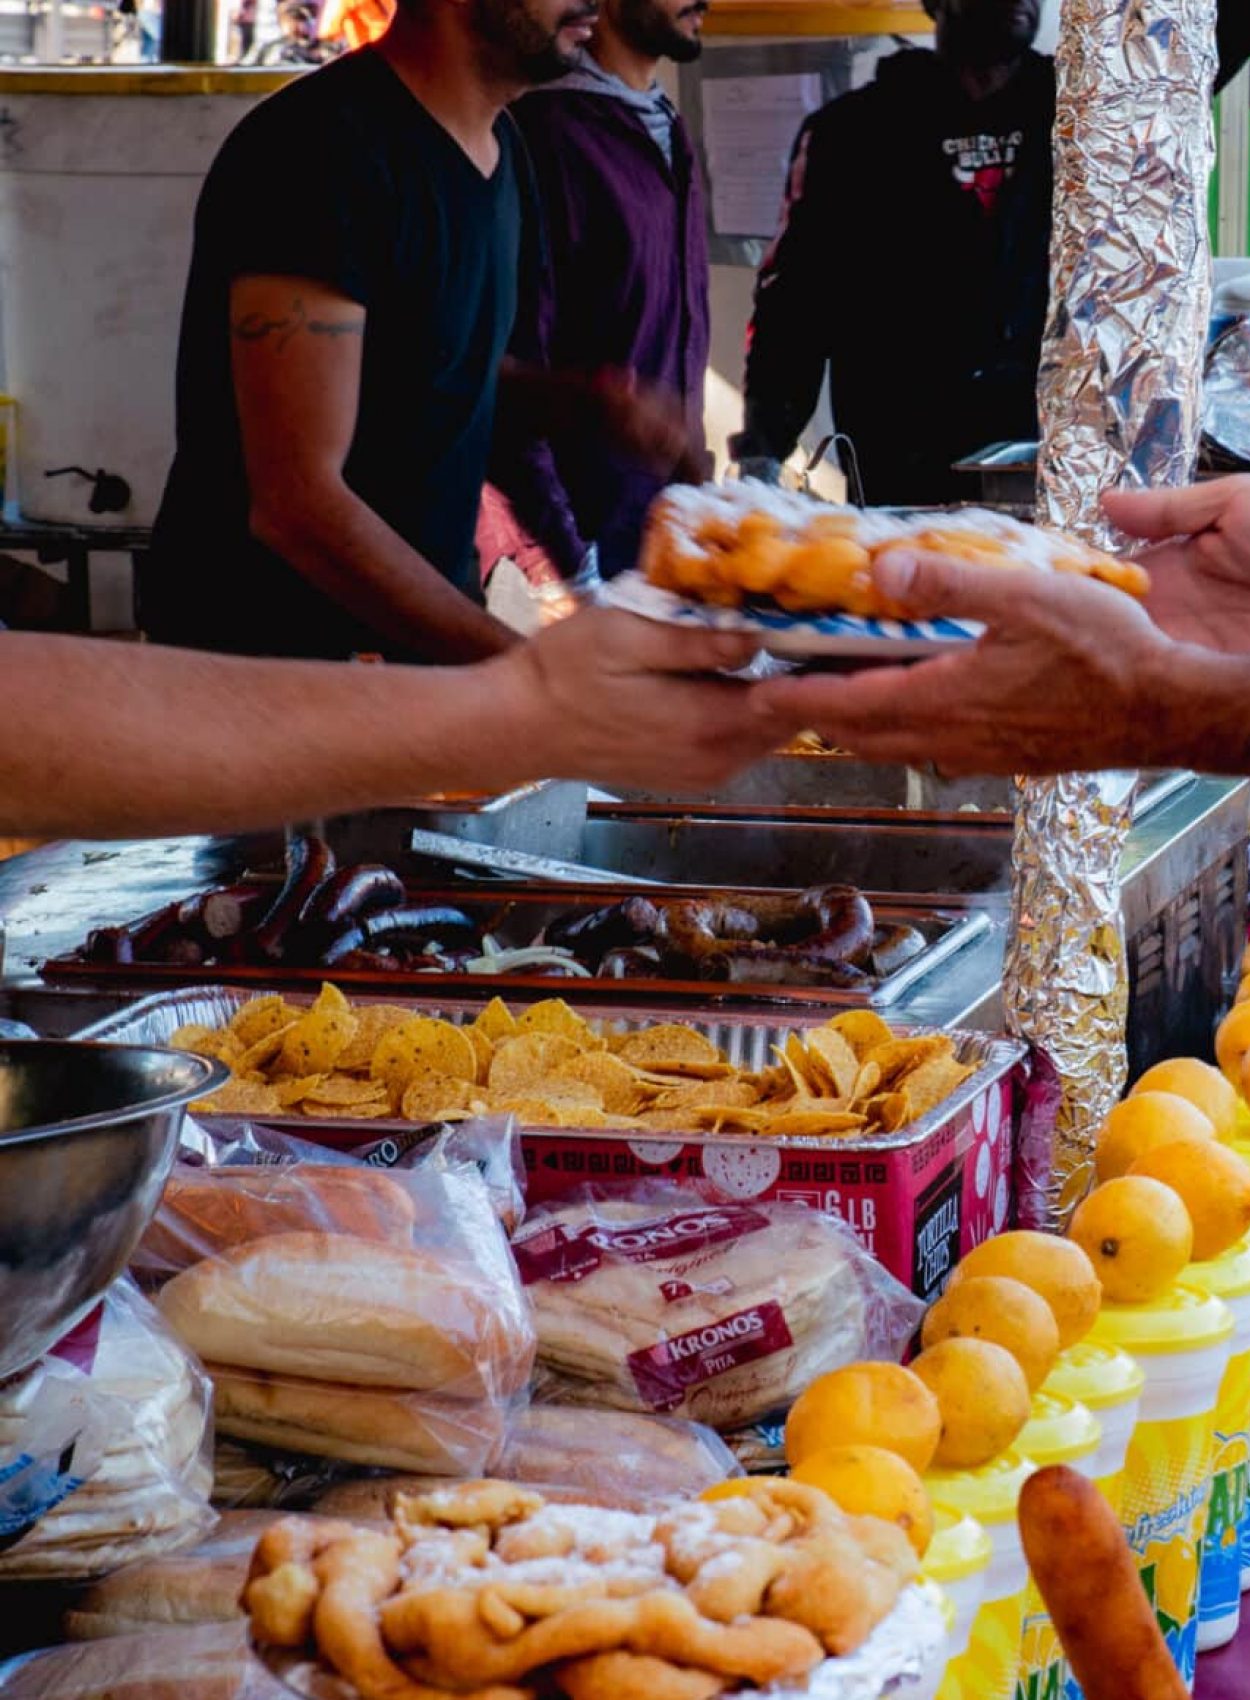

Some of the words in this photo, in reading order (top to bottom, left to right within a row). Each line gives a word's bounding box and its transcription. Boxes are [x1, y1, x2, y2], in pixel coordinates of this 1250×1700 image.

[848, 1198, 876, 1230] LB
[668, 1310, 764, 1361] KRONOS
[703, 1353, 736, 1375] PITA
